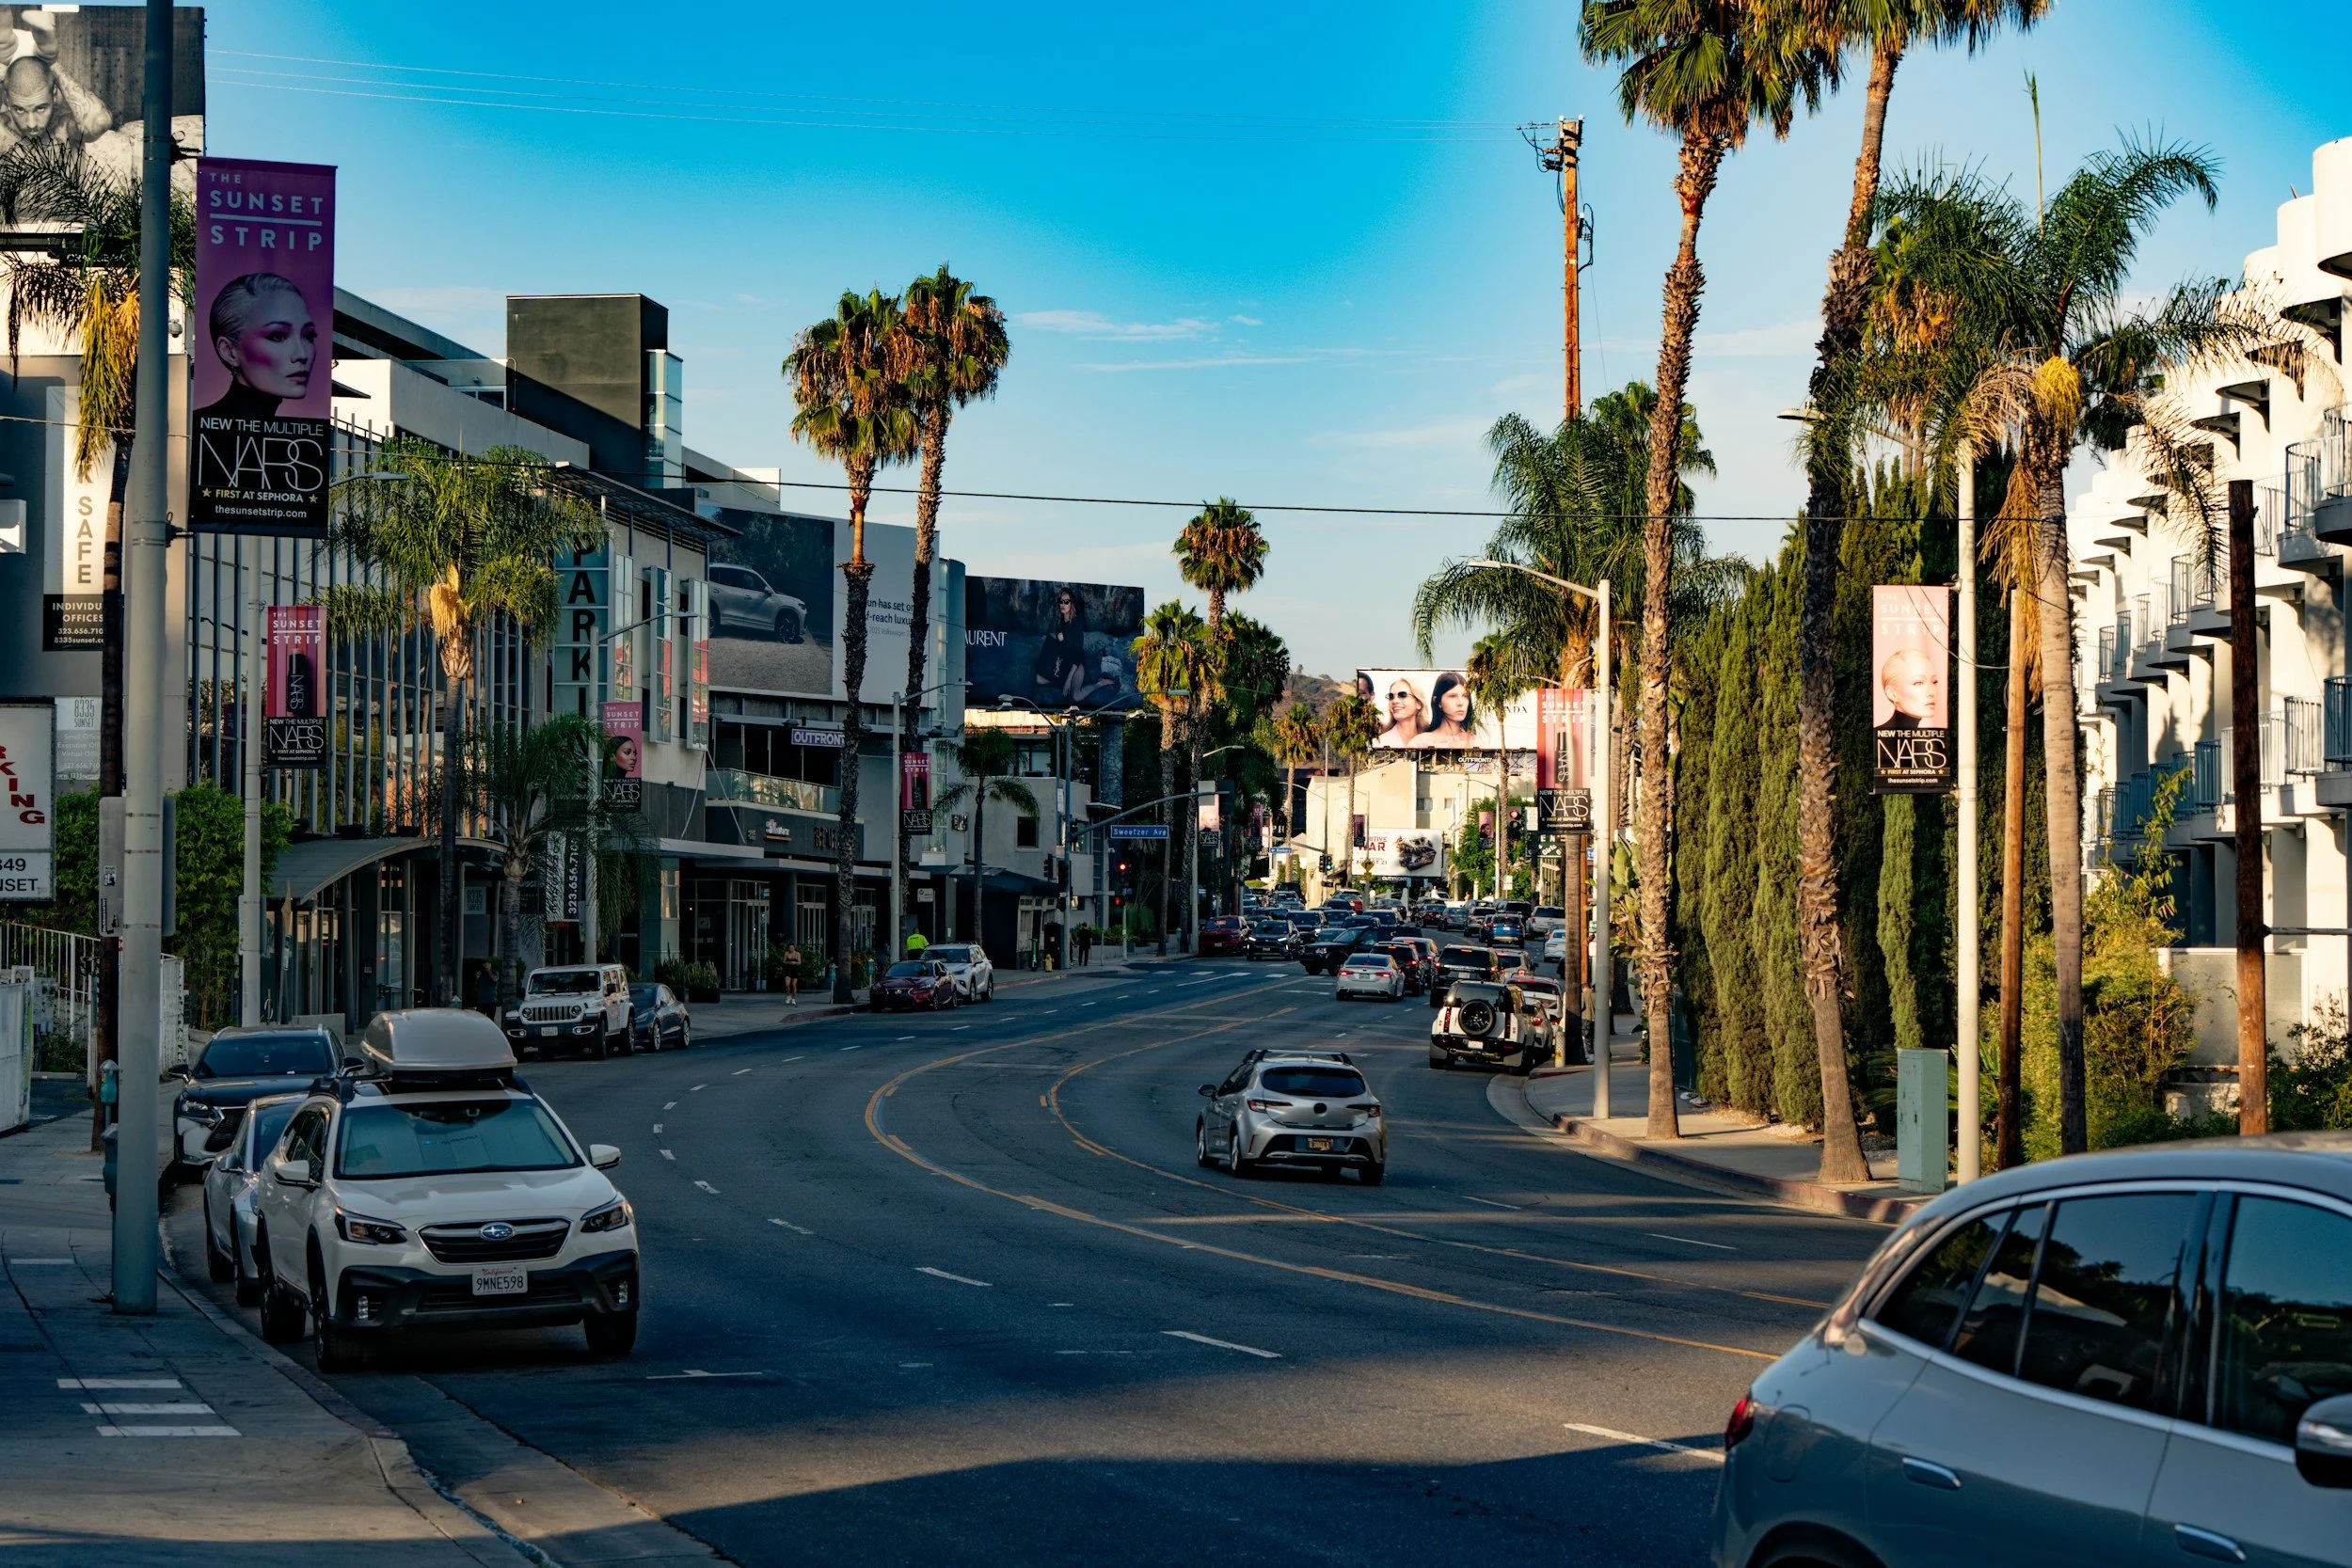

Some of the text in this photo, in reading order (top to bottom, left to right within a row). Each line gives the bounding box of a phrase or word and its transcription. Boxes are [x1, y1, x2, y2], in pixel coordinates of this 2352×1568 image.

[209, 172, 242, 184] THE
[209, 189, 324, 215] SUNSET
[210, 225, 323, 251] STRIP
[200, 417, 324, 436] NEW THE MULTIPLE
[198, 433, 324, 492] NARS
[215, 489, 304, 502] FIRST AT SEPHORA
[215, 504, 308, 518] thesunsetstrip.com
[76, 496, 93, 585] SAFE
[52, 602, 103, 611] INDIVIDU
[879, 598, 892, 610] has
[893, 602, 904, 611] set
[273, 620, 322, 628] SUNSET
[567, 534, 596, 719] PARKI
[866, 611, 912, 626] f-reach luxu
[273, 635, 322, 645] STRIP
[290, 674, 305, 709] NARS
[74, 699, 95, 718] 8335
[1542, 701, 1586, 709] SUNSET
[74, 718, 95, 728] SUNSET
[1542, 715, 1586, 723] STRIP
[269, 725, 324, 750] NARS
[1878, 730, 1945, 738] NEW THE MULTIPLE
[1878, 738, 1947, 768] NARS
[0, 746, 45, 824] KING
[603, 784, 641, 800] NARS
[1539, 796, 1589, 817] NARS
[904, 813, 931, 826] NARS
[476, 1275, 524, 1291] 9MNE598
